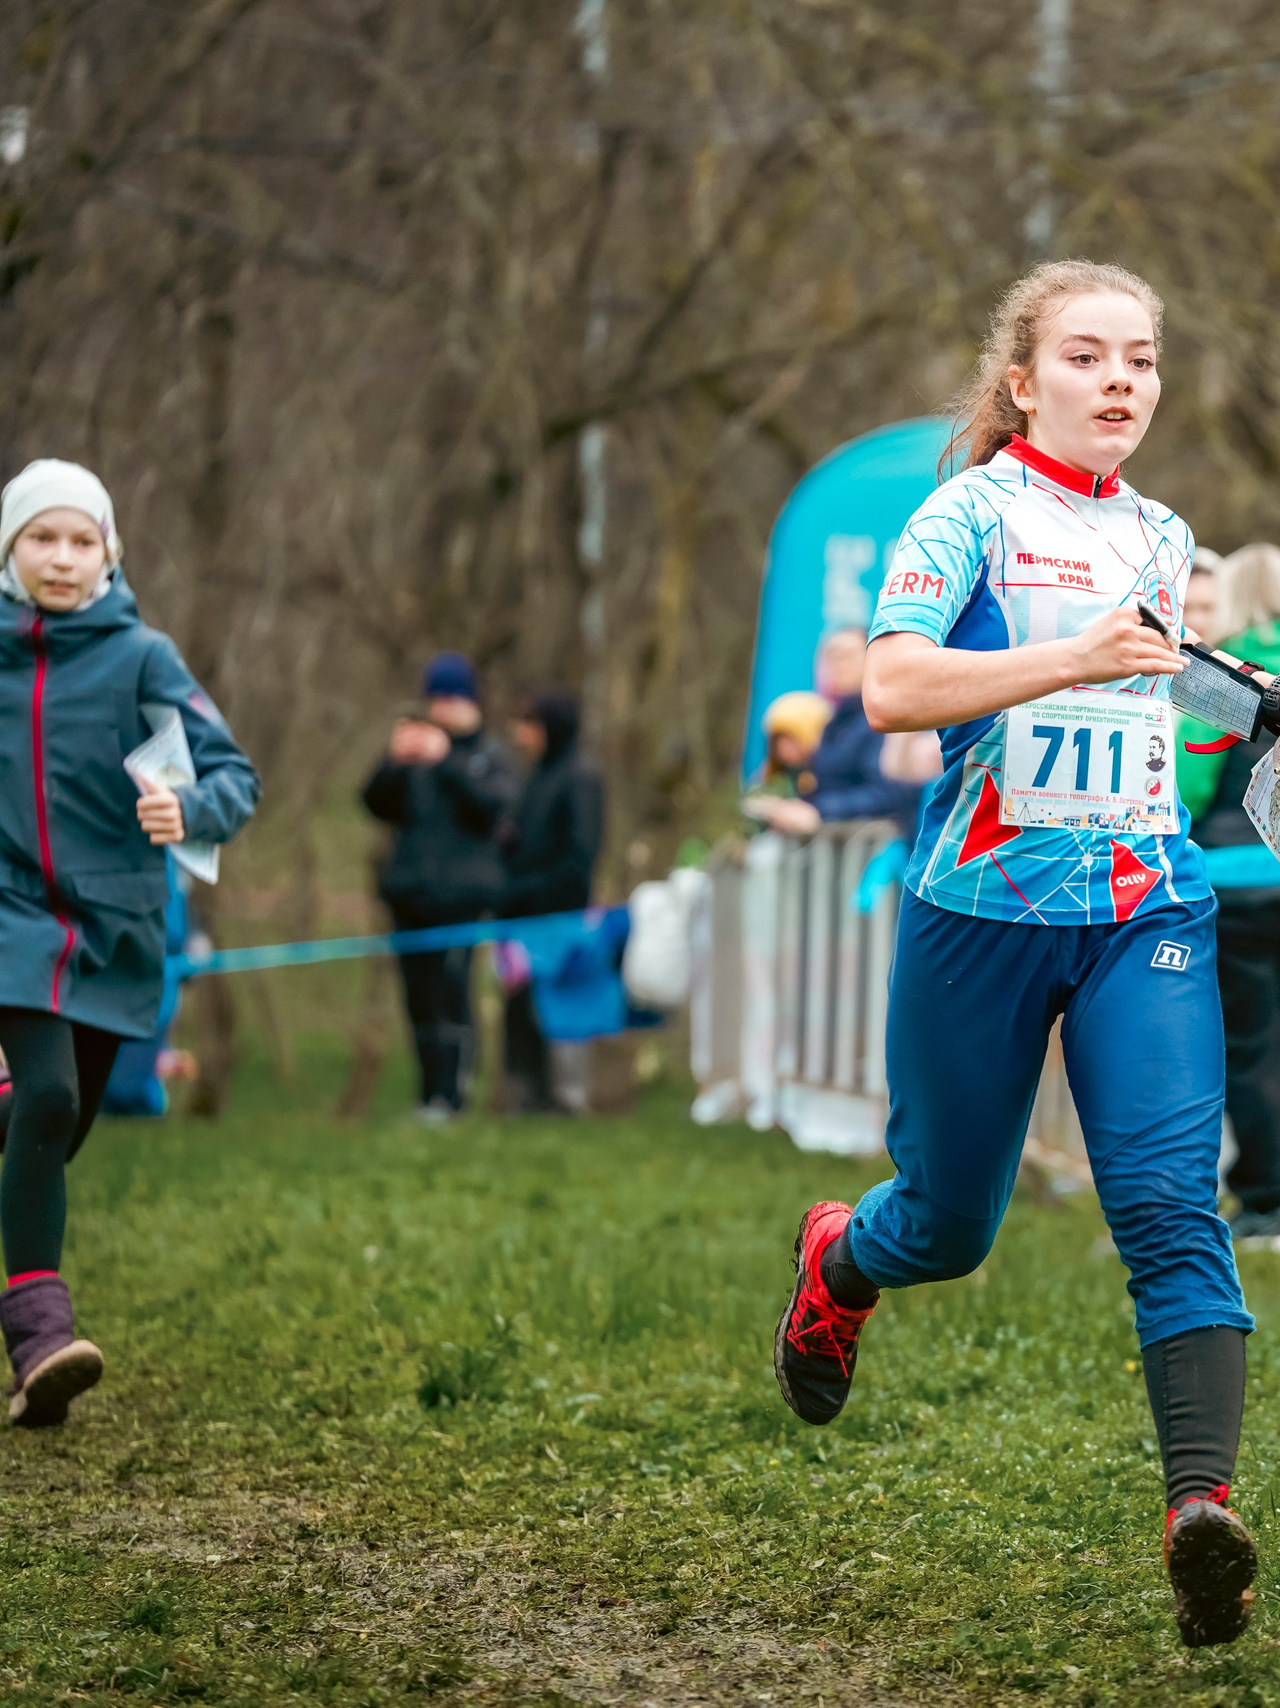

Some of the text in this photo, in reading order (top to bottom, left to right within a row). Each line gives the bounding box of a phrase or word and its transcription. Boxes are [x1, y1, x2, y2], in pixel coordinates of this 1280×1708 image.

[1016, 552, 1091, 573] ПЕРМСКИЙ
[1058, 573, 1093, 588] КРАЙ
[1041, 712, 1084, 721] СПОРТИВНОМУ
[1069, 705, 1107, 714] СПОРТИВНЫЕ
[1031, 724, 1123, 794] 711
[1011, 788, 1037, 797] Памяти
[1038, 791, 1068, 799] военного
[1069, 793, 1104, 802] топографа
[1116, 873, 1147, 887] OLLY
